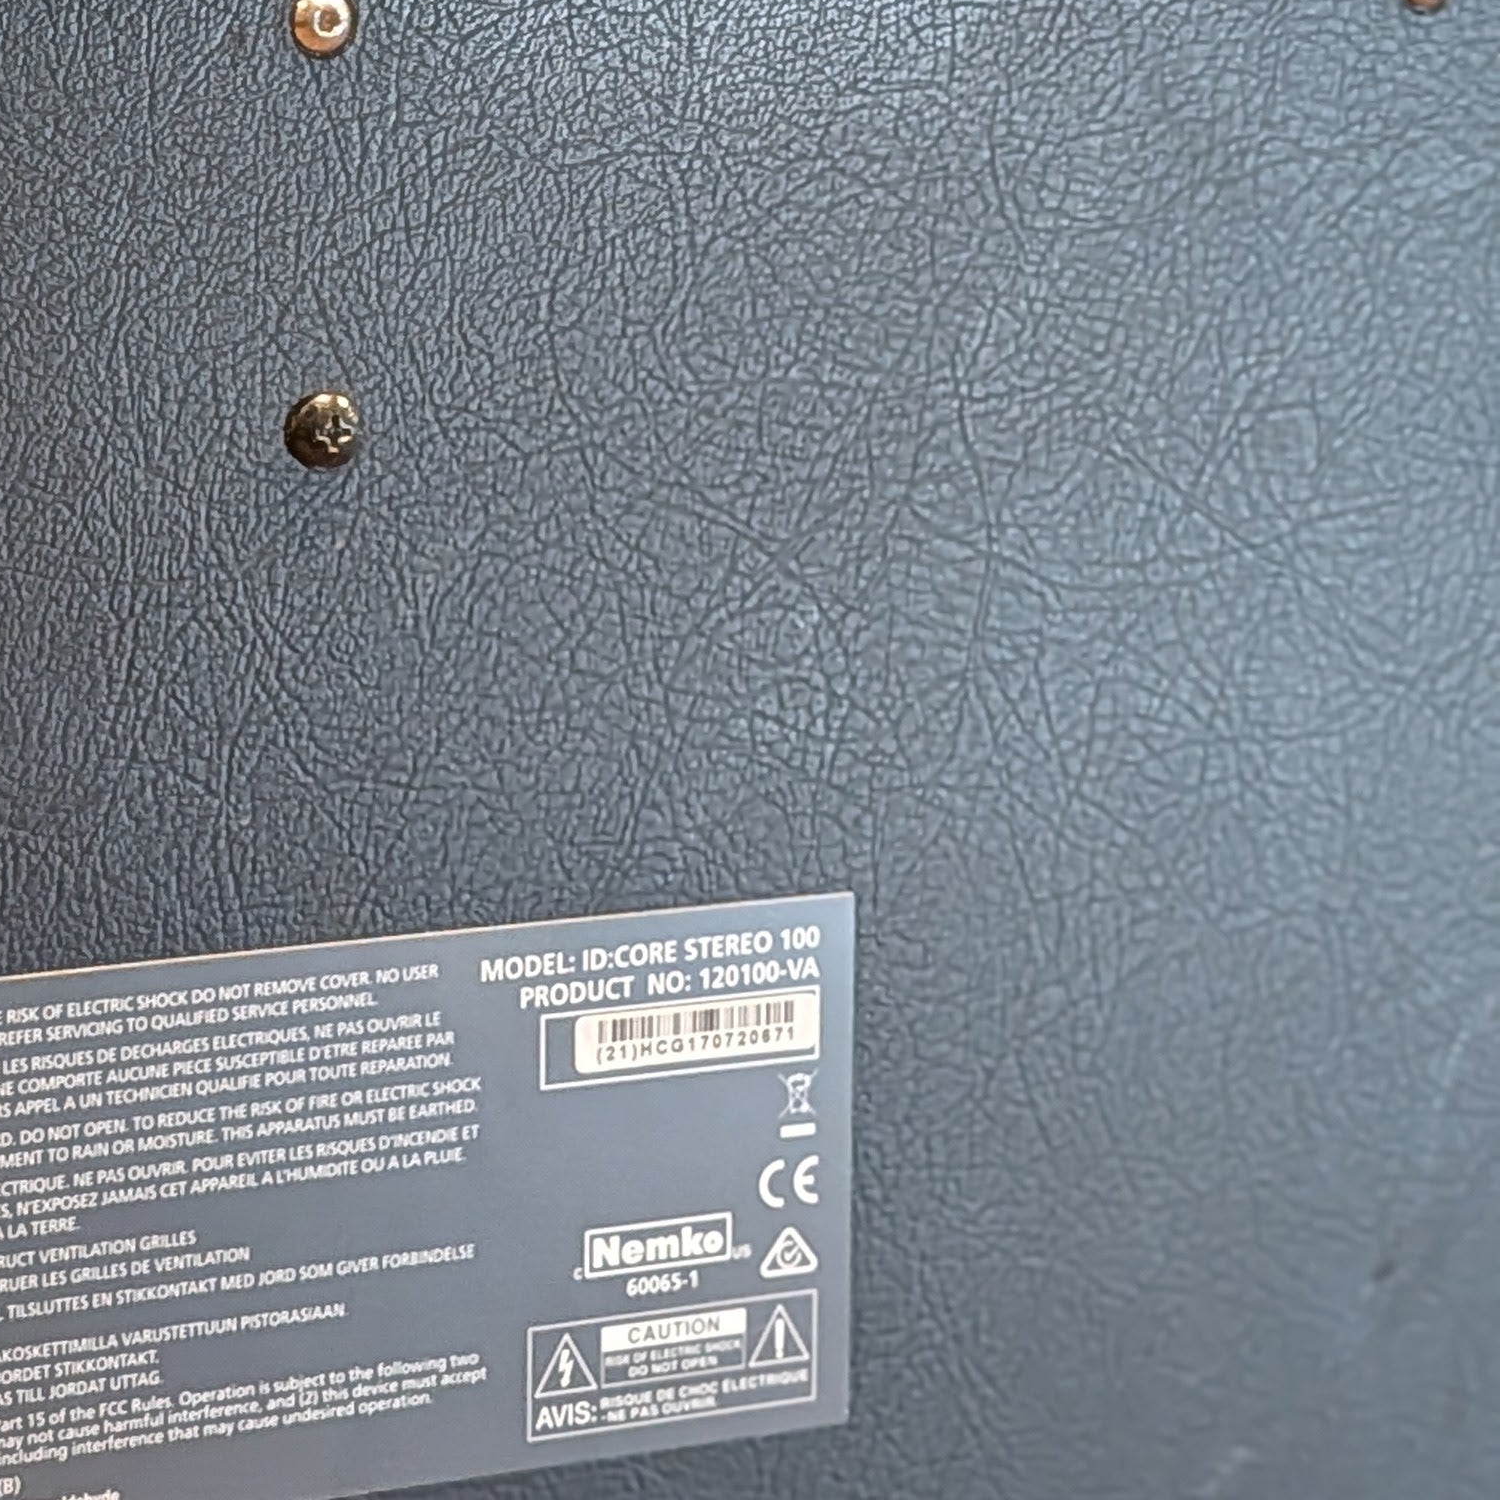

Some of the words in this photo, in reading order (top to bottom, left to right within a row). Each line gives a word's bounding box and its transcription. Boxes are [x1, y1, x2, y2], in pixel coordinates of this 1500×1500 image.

[480, 955, 576, 982] MODEL:
[582, 940, 677, 971] ID:CORE
[684, 930, 773, 962] STEREO
[781, 925, 820, 950] 100
[6, 1005, 38, 1025] RISK
[42, 1003, 63, 1022] OF
[67, 995, 134, 1019] ELECTRIC
[136, 990, 187, 1012] SHOCK
[191, 987, 215, 1006] DO
[218, 983, 250, 1003] NOT
[254, 977, 315, 999] REMOVE
[376, 968, 398, 986] NO
[402, 964, 438, 984] USER
[520, 976, 634, 1009] PRODUCT
[647, 971, 691, 995] NO:
[699, 956, 819, 989] 120100-VA
[46, 1018, 122, 1042] SERVICING
[126, 1016, 147, 1033] TO
[151, 1007, 228, 1030] QUALIFIED
[232, 1001, 288, 1022] SERVICE
[3, 1056, 27, 1075] LES
[31, 1049, 92, 1072] RISQUES
[96, 1046, 116, 1065] DE
[120, 1036, 208, 1062] DECHARGES
[314, 1023, 334, 1041] NE
[337, 1020, 363, 1038] PAS
[367, 1013, 421, 1035] OUVRIR
[425, 1011, 440, 1029] LE
[17, 1070, 102, 1095] COMPORTE
[106, 1062, 168, 1085] AUCUNE
[172, 1058, 211, 1077] PIECE
[215, 1047, 304, 1073] SUSCEPTIBLE
[361, 1034, 422, 1056] REPAREE
[426, 1031, 454, 1049] PAR
[7, 1222, 27, 1240] LA
[39, 1237, 135, 1265] VENTILATION
[140, 1229, 196, 1252] GRILLES
[593, 1225, 724, 1268] Nemko
[42, 1269, 66, 1288] LES
[70, 1261, 126, 1284] GRILLES
[131, 1258, 150, 1277] DE
[154, 1245, 249, 1274] VENTILATION
[626, 1269, 699, 1298] 60065-1
[627, 1315, 721, 1345] CAUTION
[16, 1385, 44, 1405] TILL
[48, 1377, 105, 1400] JORDAT
[535, 1401, 598, 1431] AVIS:
